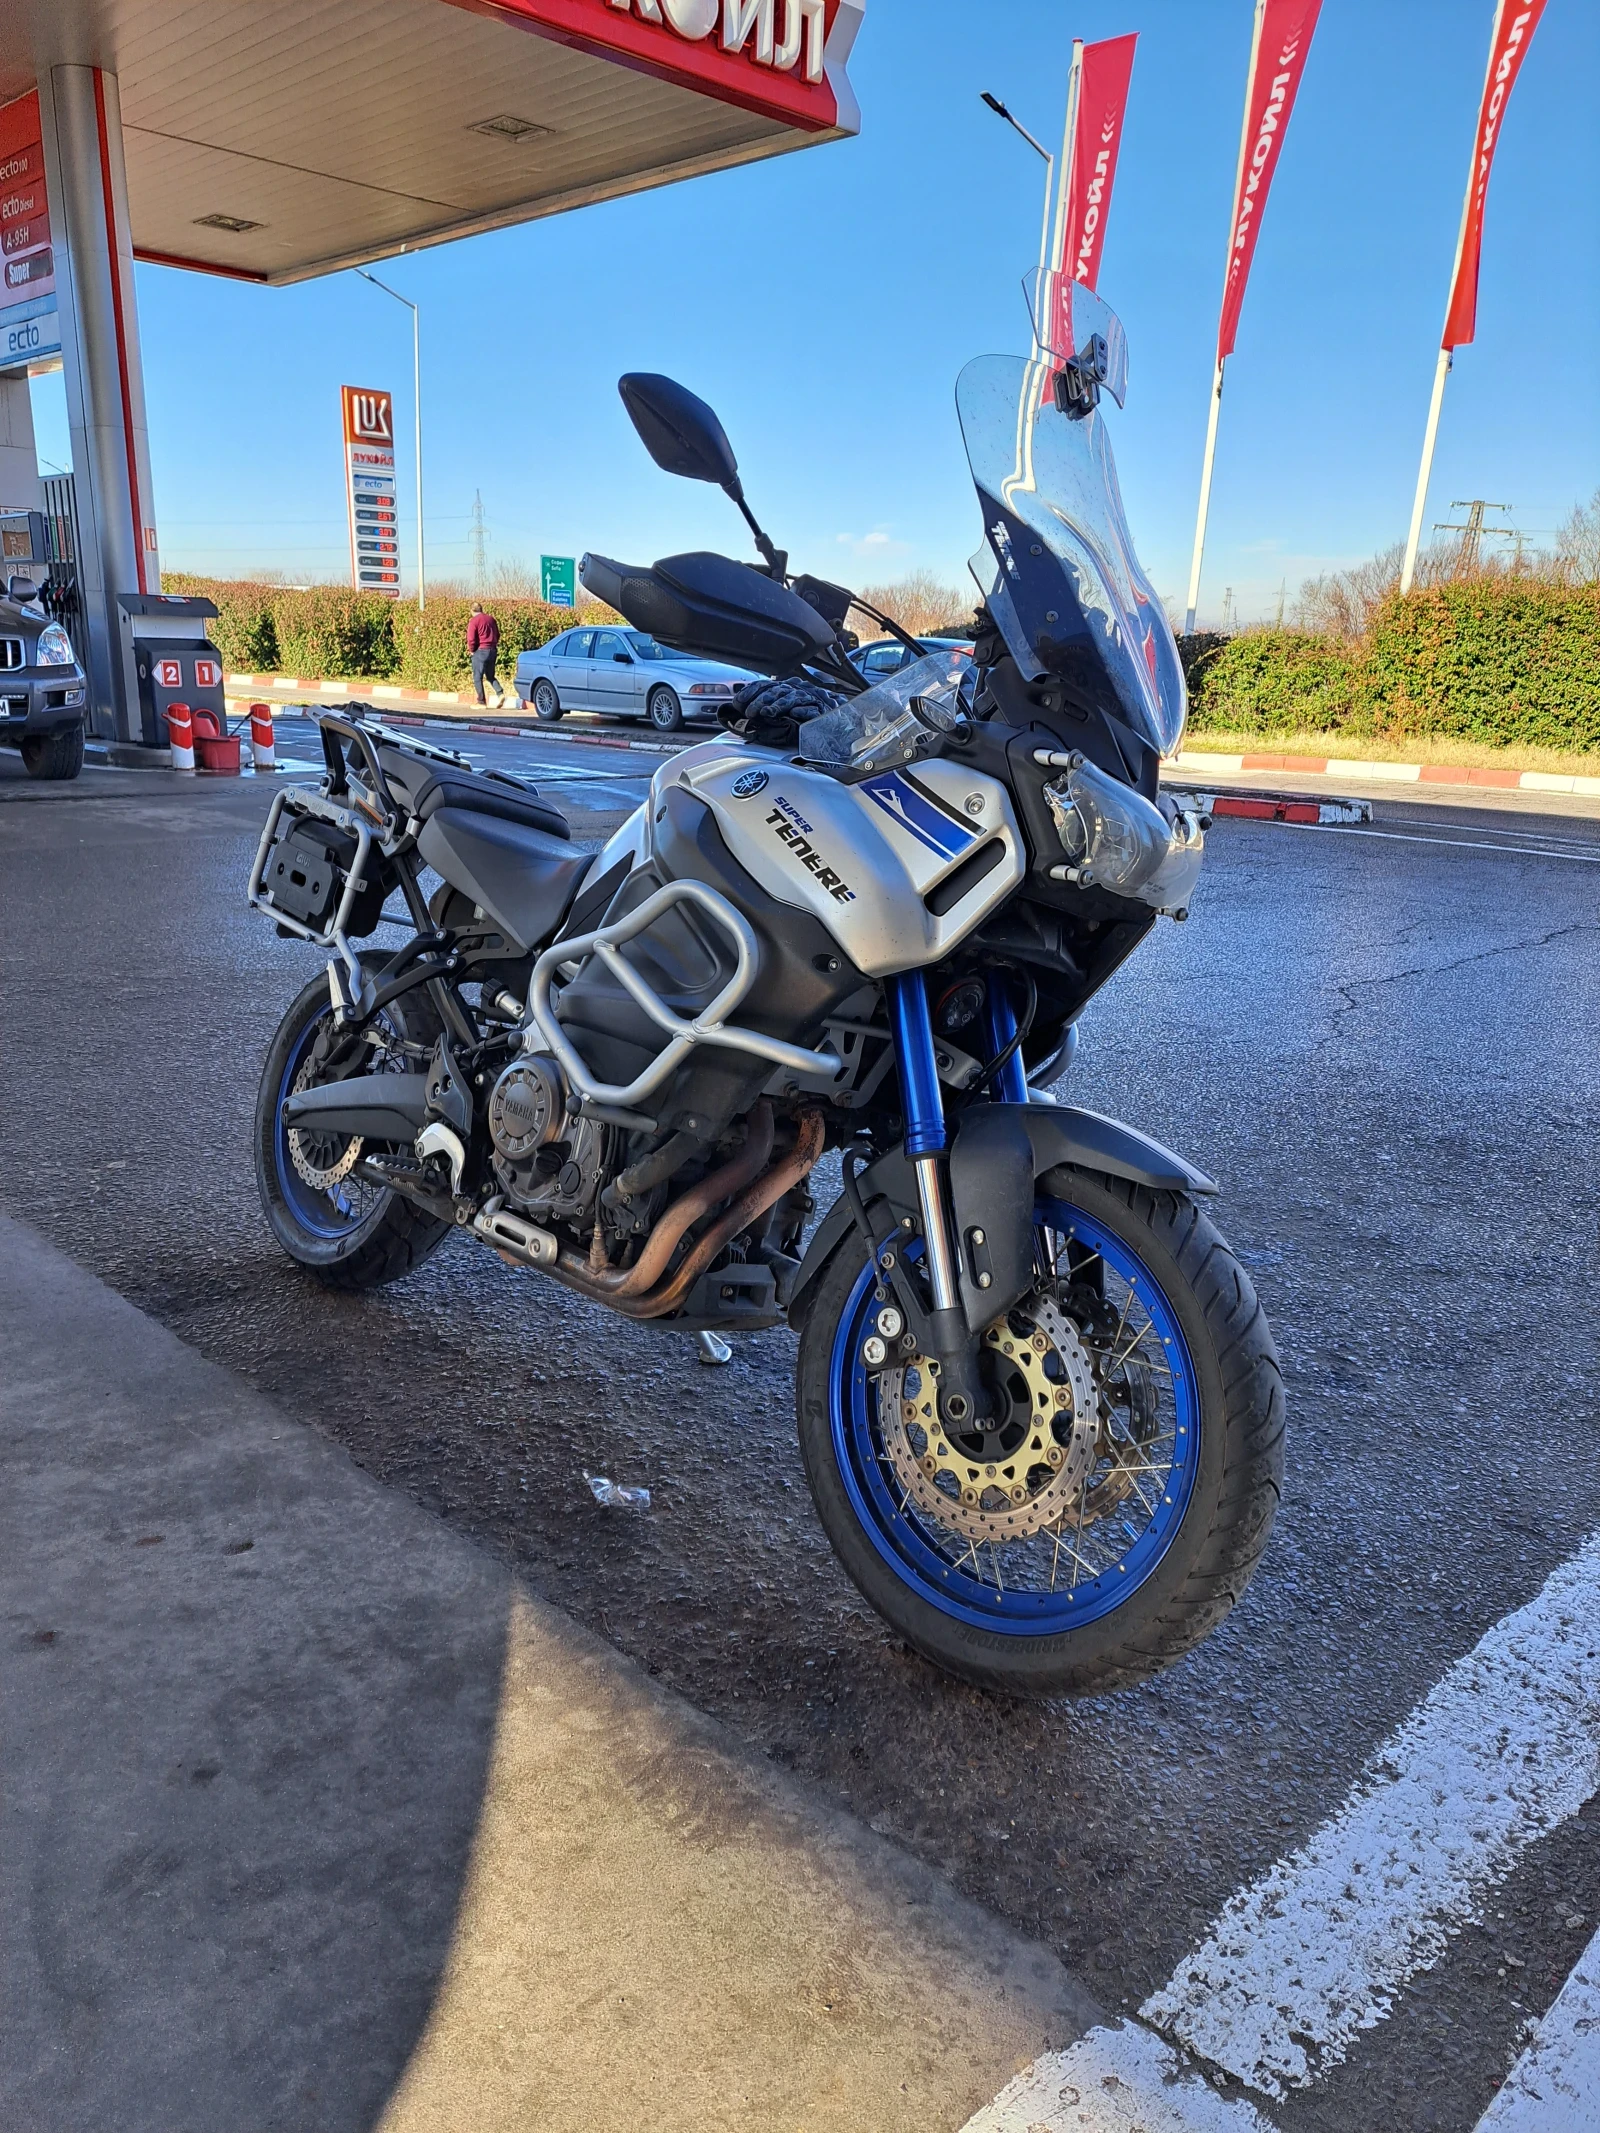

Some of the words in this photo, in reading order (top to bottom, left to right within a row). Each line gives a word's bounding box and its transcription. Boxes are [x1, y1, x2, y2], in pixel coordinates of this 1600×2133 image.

[9, 261, 30, 284] Super
[9, 323, 39, 351] ecto
[364, 480, 383, 488] ecto
[165, 667, 178, 681] 2
[202, 667, 209, 681] 1
[773, 796, 814, 834] SUPER
[504, 1098, 534, 1122] YAMAHA
